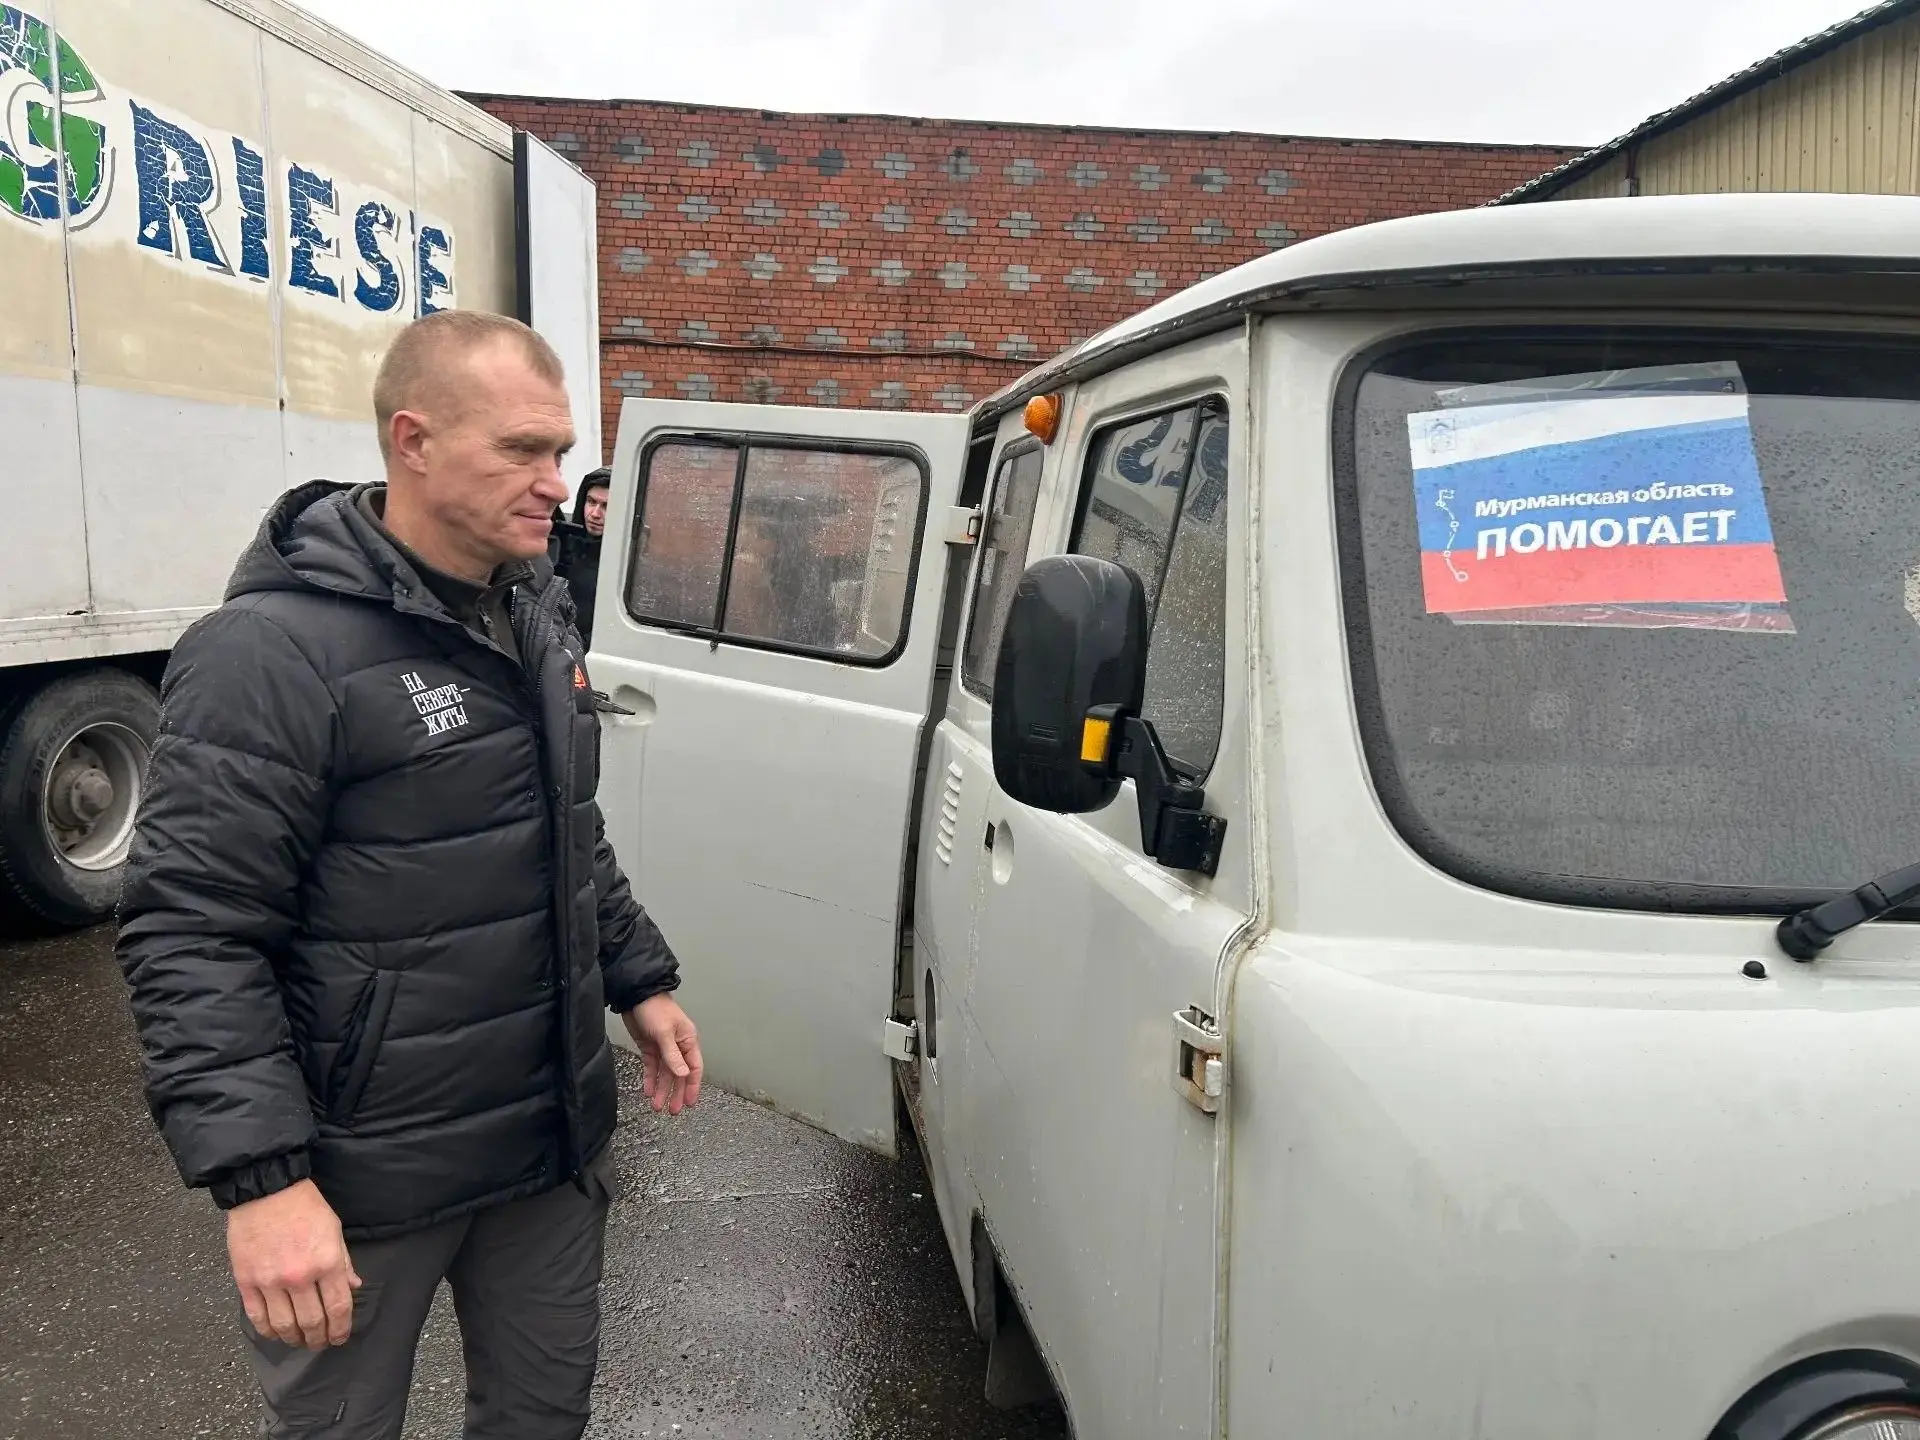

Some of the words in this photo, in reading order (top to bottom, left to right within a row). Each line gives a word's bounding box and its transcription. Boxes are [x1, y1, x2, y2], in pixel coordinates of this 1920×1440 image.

[1475, 491, 1628, 517] Мурманская
[1632, 481, 1734, 503] область
[1476, 509, 1736, 560] ПОМОГАЕТ
[400, 671, 427, 693] НА
[421, 704, 469, 736] ЖИТЬ!
